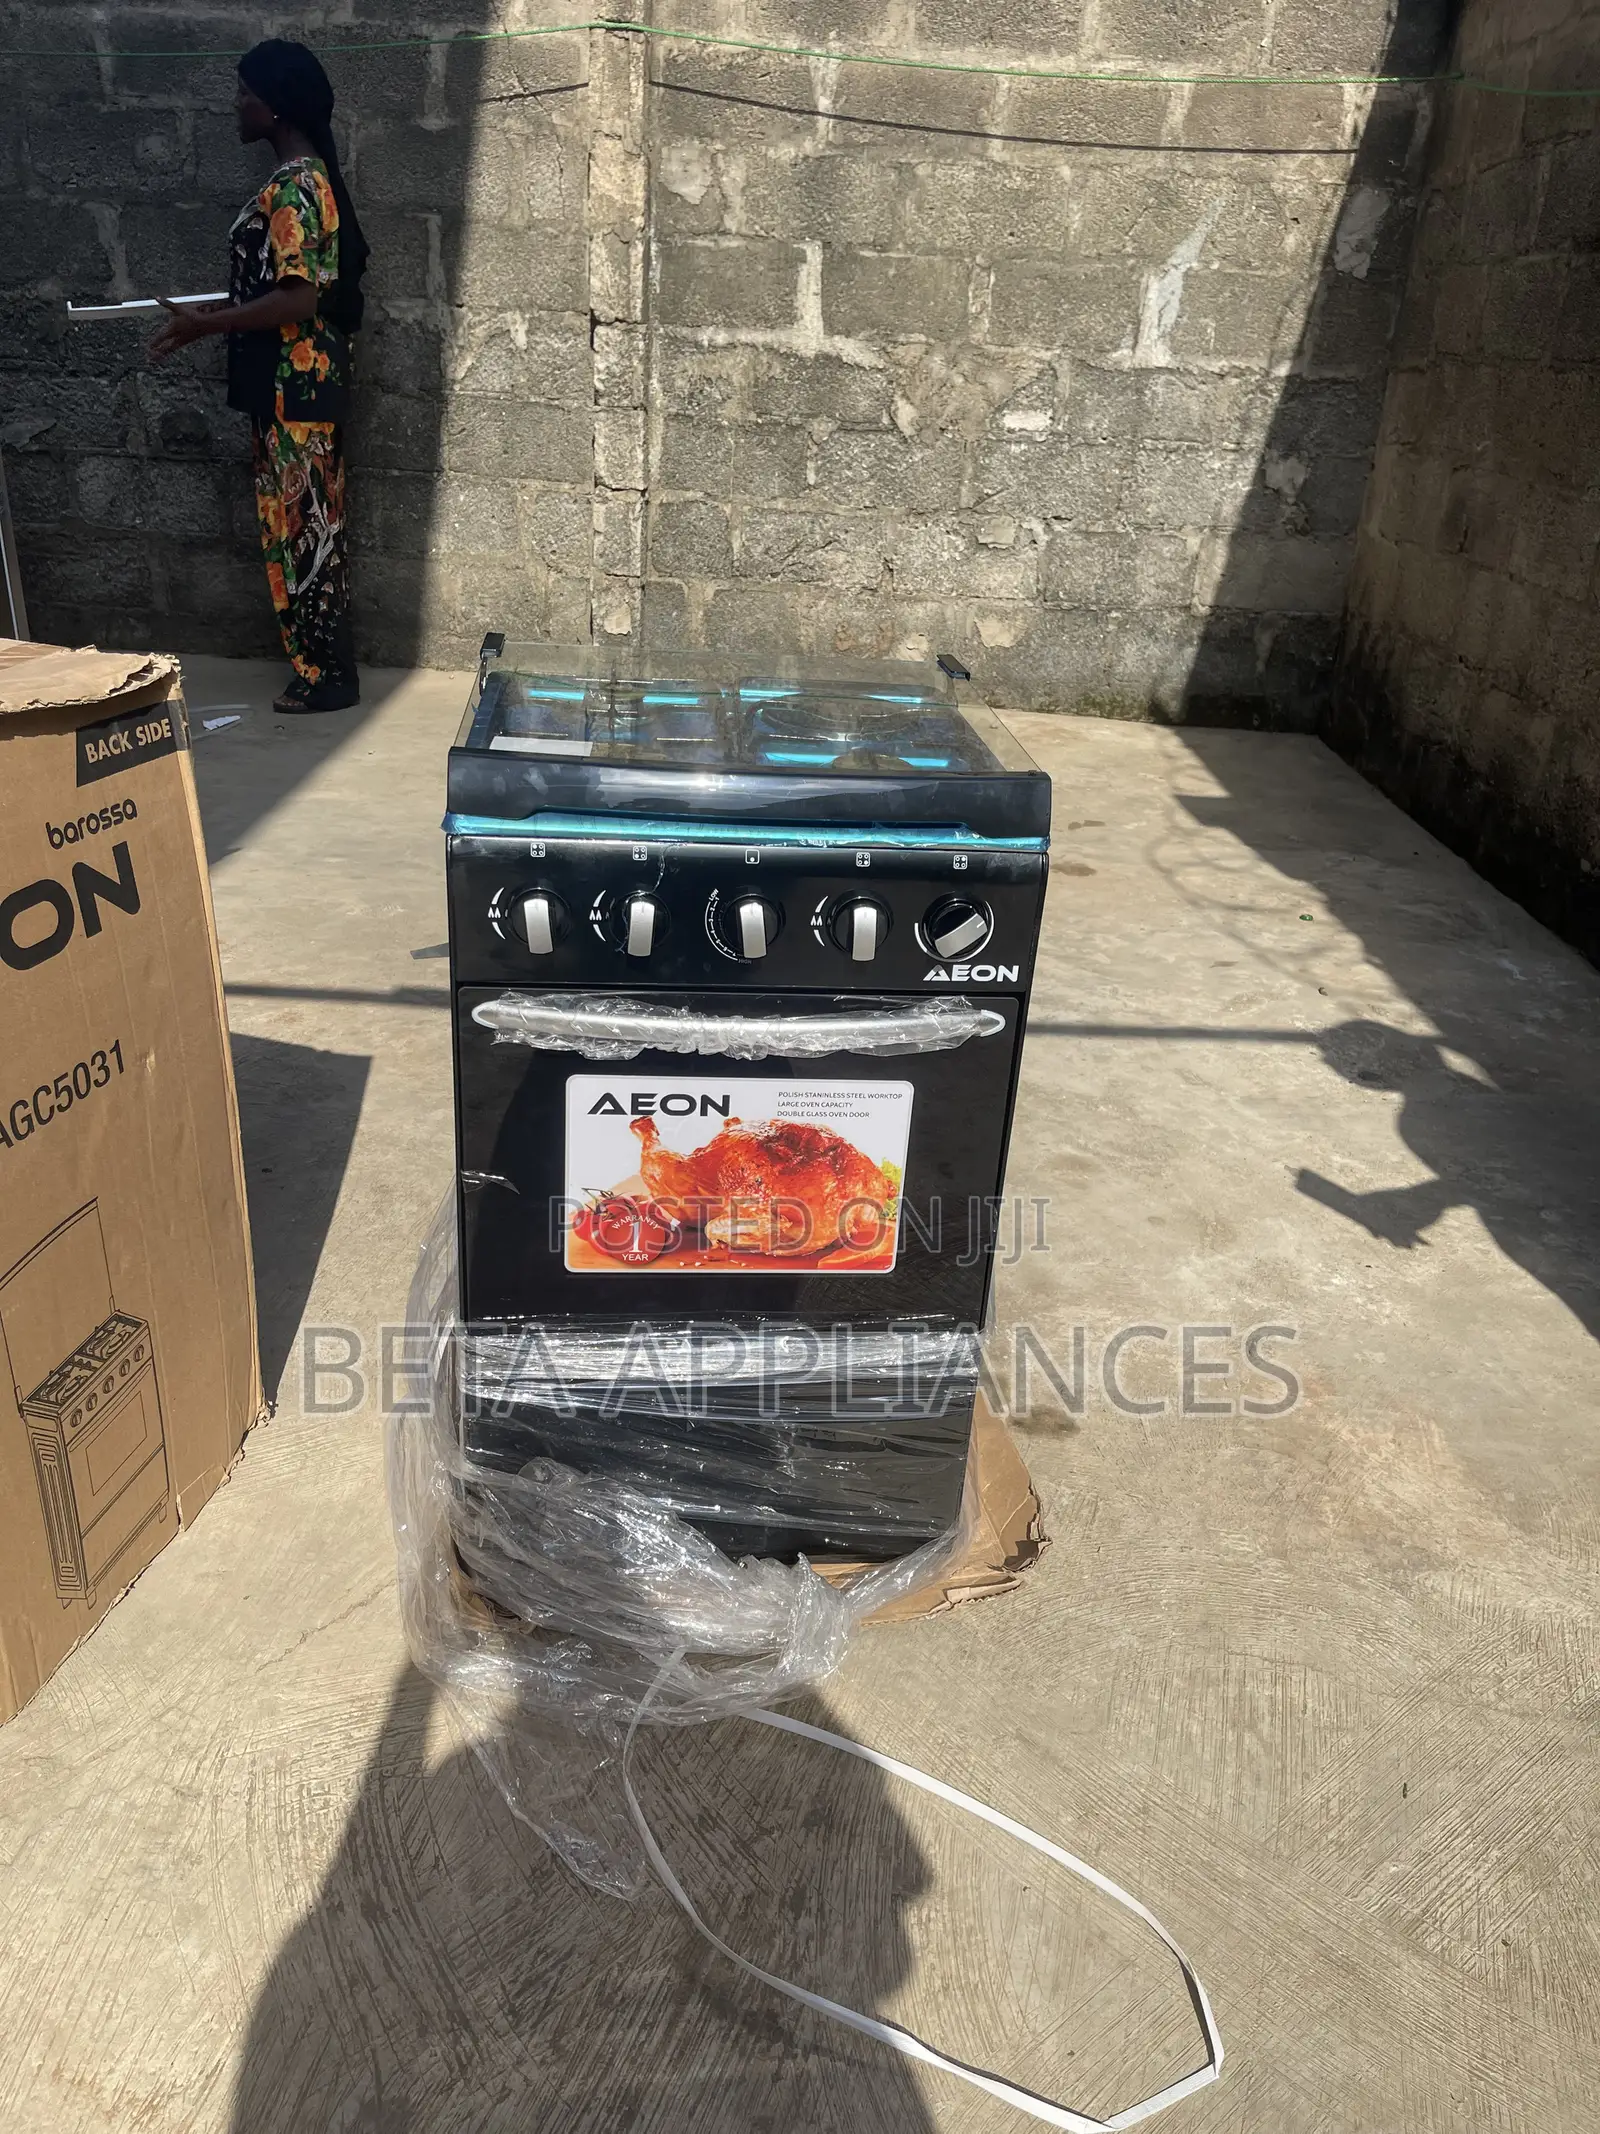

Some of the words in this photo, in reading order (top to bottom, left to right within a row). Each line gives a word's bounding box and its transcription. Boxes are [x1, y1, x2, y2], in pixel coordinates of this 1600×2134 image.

[85, 730, 132, 764] BACK
[136, 718, 172, 747] SIDE
[46, 798, 138, 850] barossa
[923, 964, 1020, 982] AEON
[587, 1092, 731, 1117] AEON
[611, 1214, 661, 1231] WARRANTY
[628, 1221, 643, 1253] 1
[622, 1253, 649, 1262] YEAR
